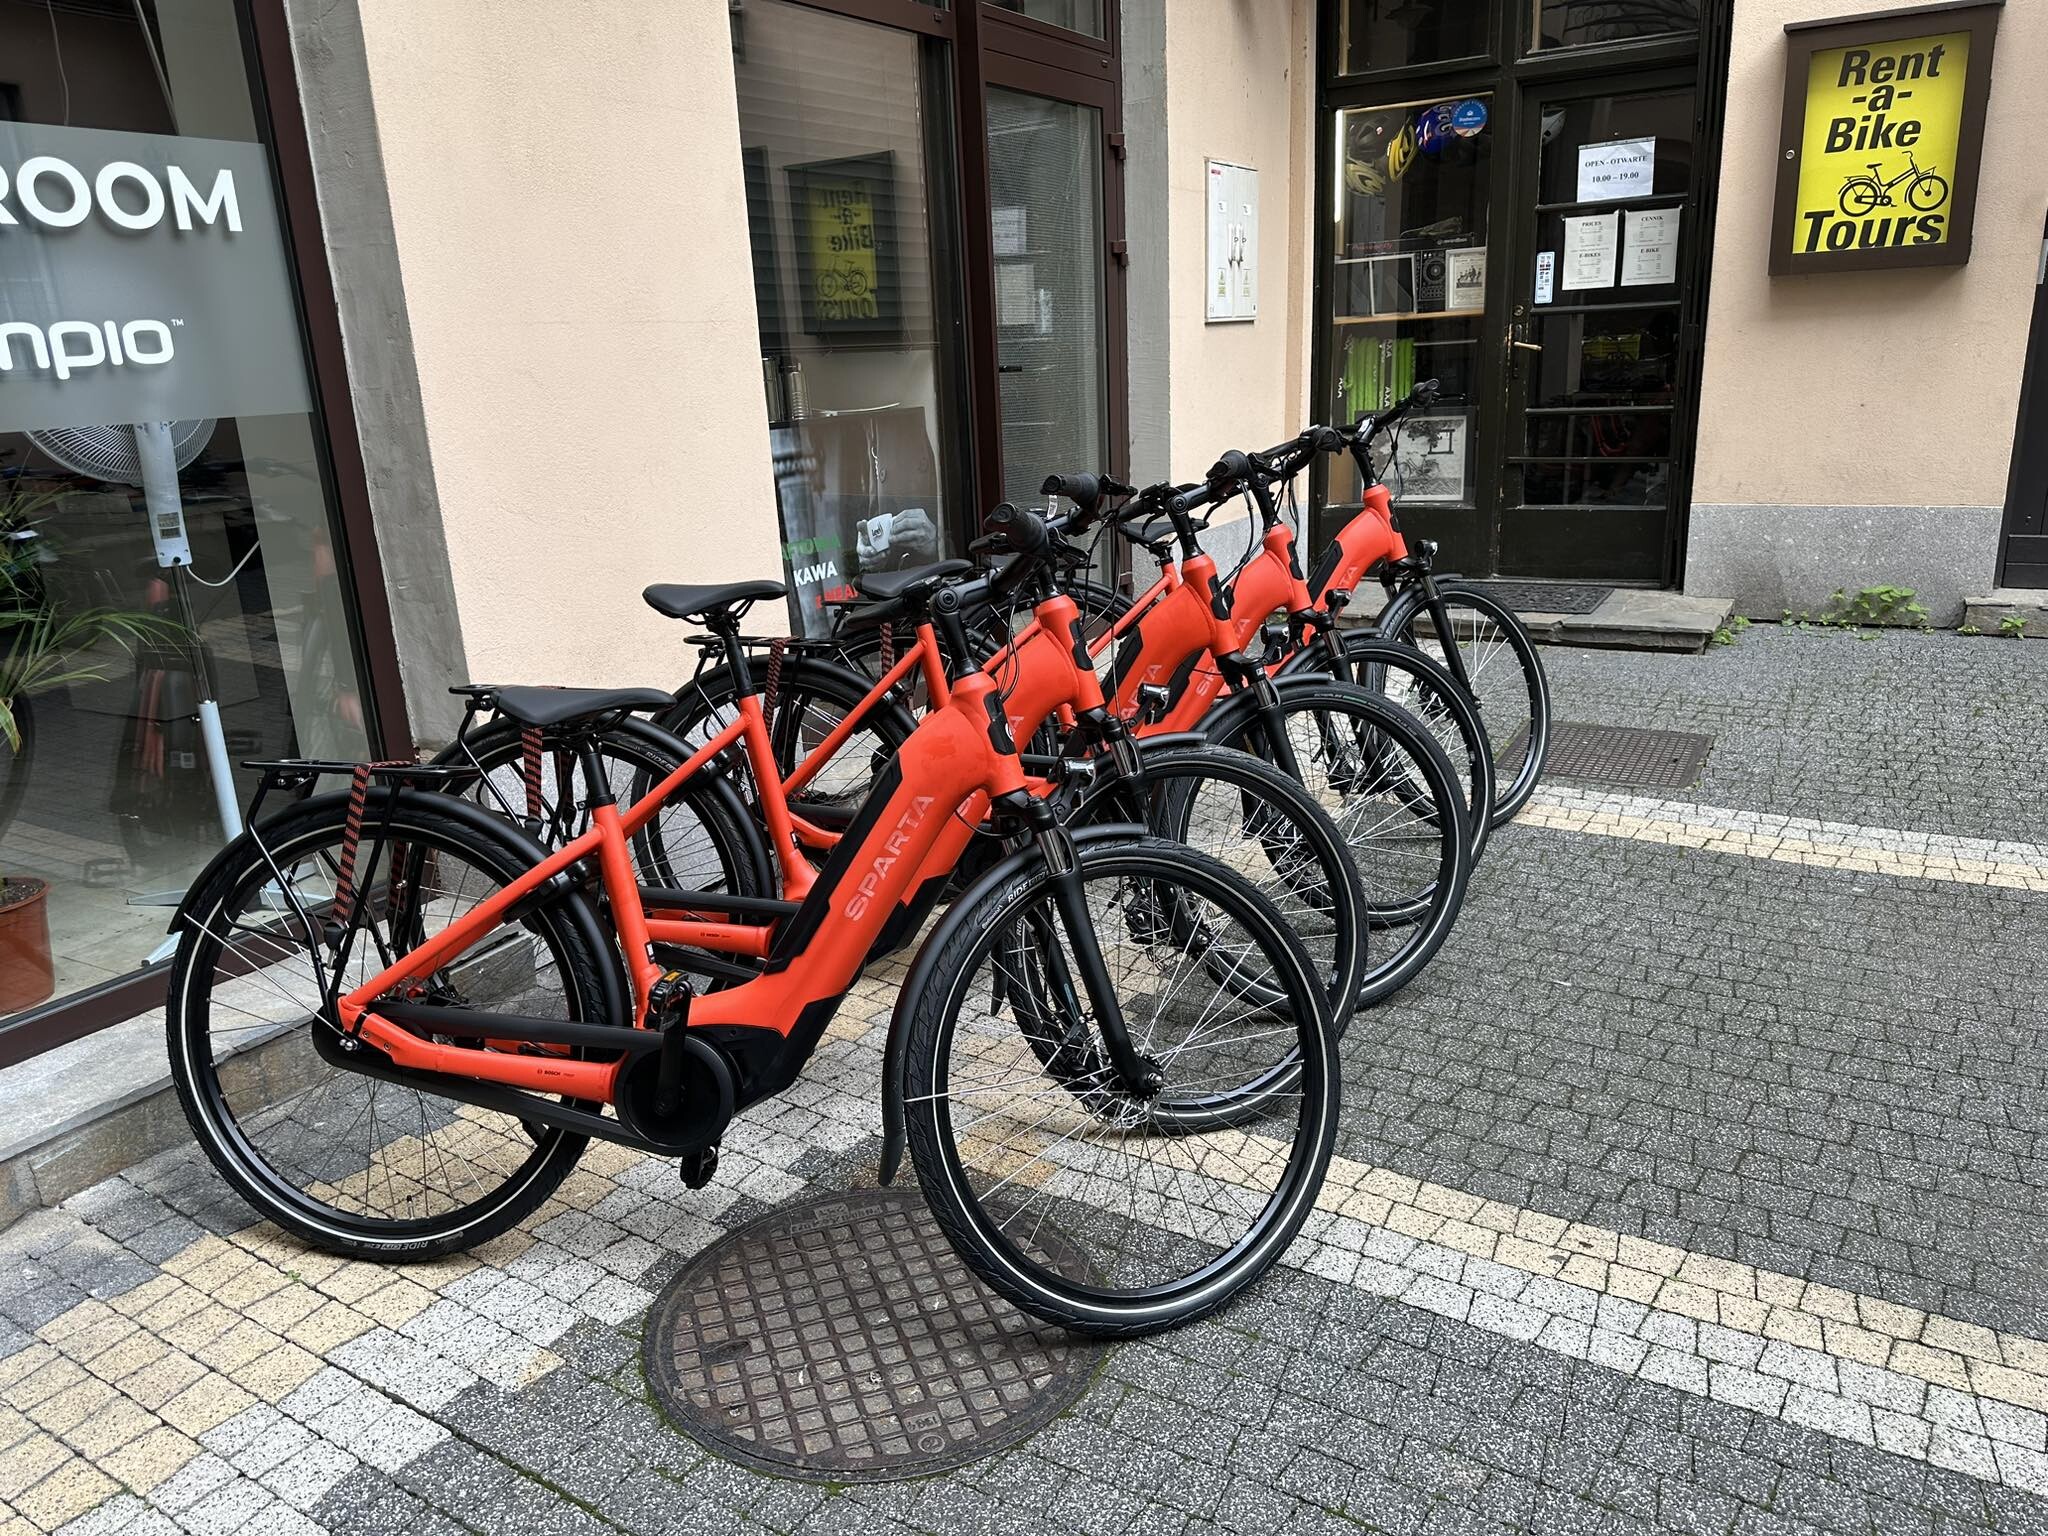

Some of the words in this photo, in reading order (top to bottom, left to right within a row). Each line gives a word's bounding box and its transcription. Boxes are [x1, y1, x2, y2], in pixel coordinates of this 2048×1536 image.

[1837, 44, 1946, 88] Rent
[1852, 84, 1913, 113] -a-
[1824, 113, 1922, 154] Bike
[1584, 160, 1605, 168] OPEN
[1610, 155, 1648, 167] OTWARTE
[1592, 174, 1611, 183] 10.00
[1619, 171, 1639, 181] 19.00
[1804, 209, 1945, 253] Tours
[793, 560, 839, 588] KAWA
[844, 795, 936, 921] SPARTA
